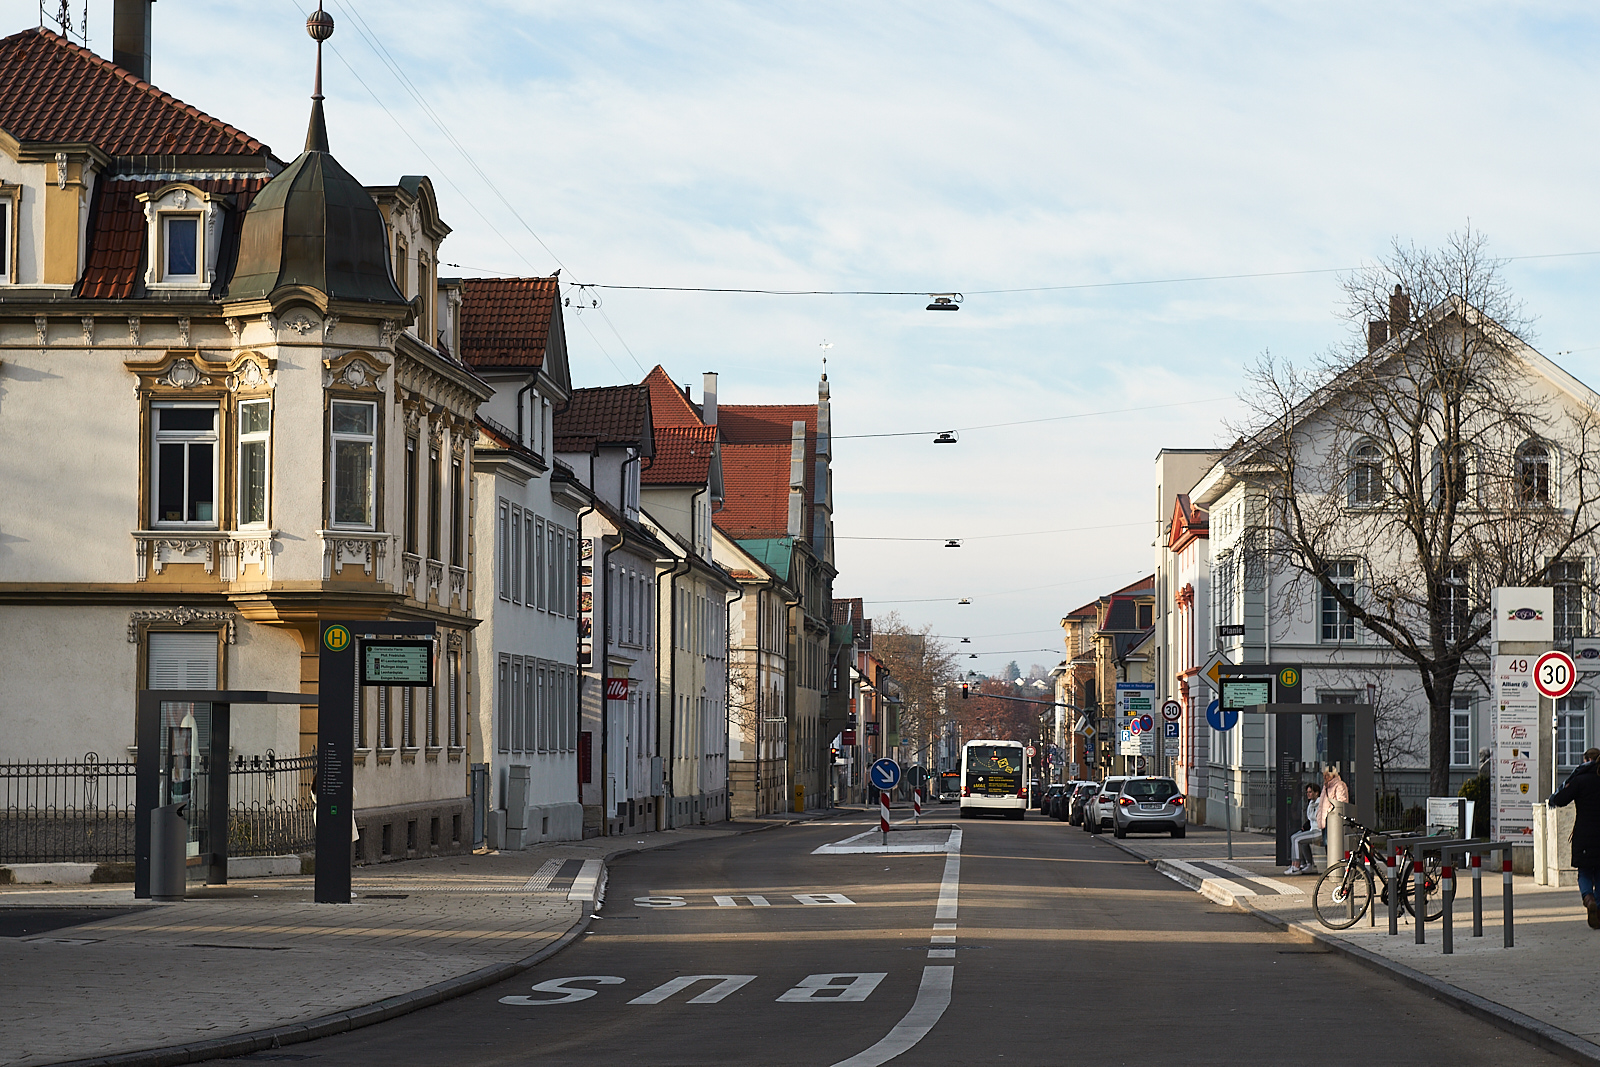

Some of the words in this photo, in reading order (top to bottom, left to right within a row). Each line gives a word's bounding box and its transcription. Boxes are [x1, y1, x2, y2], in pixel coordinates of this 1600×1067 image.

[1222, 626, 1243, 635] Planie
[332, 631, 342, 645] H
[1509, 659, 1528, 673] 49
[1285, 672, 1293, 683] H
[1543, 664, 1566, 685] 30
[607, 680, 627, 698] illy
[1165, 705, 1178, 716] 30
[1166, 724, 1175, 736] P
[633, 893, 857, 908] BUS
[498, 972, 888, 1006] BUS
